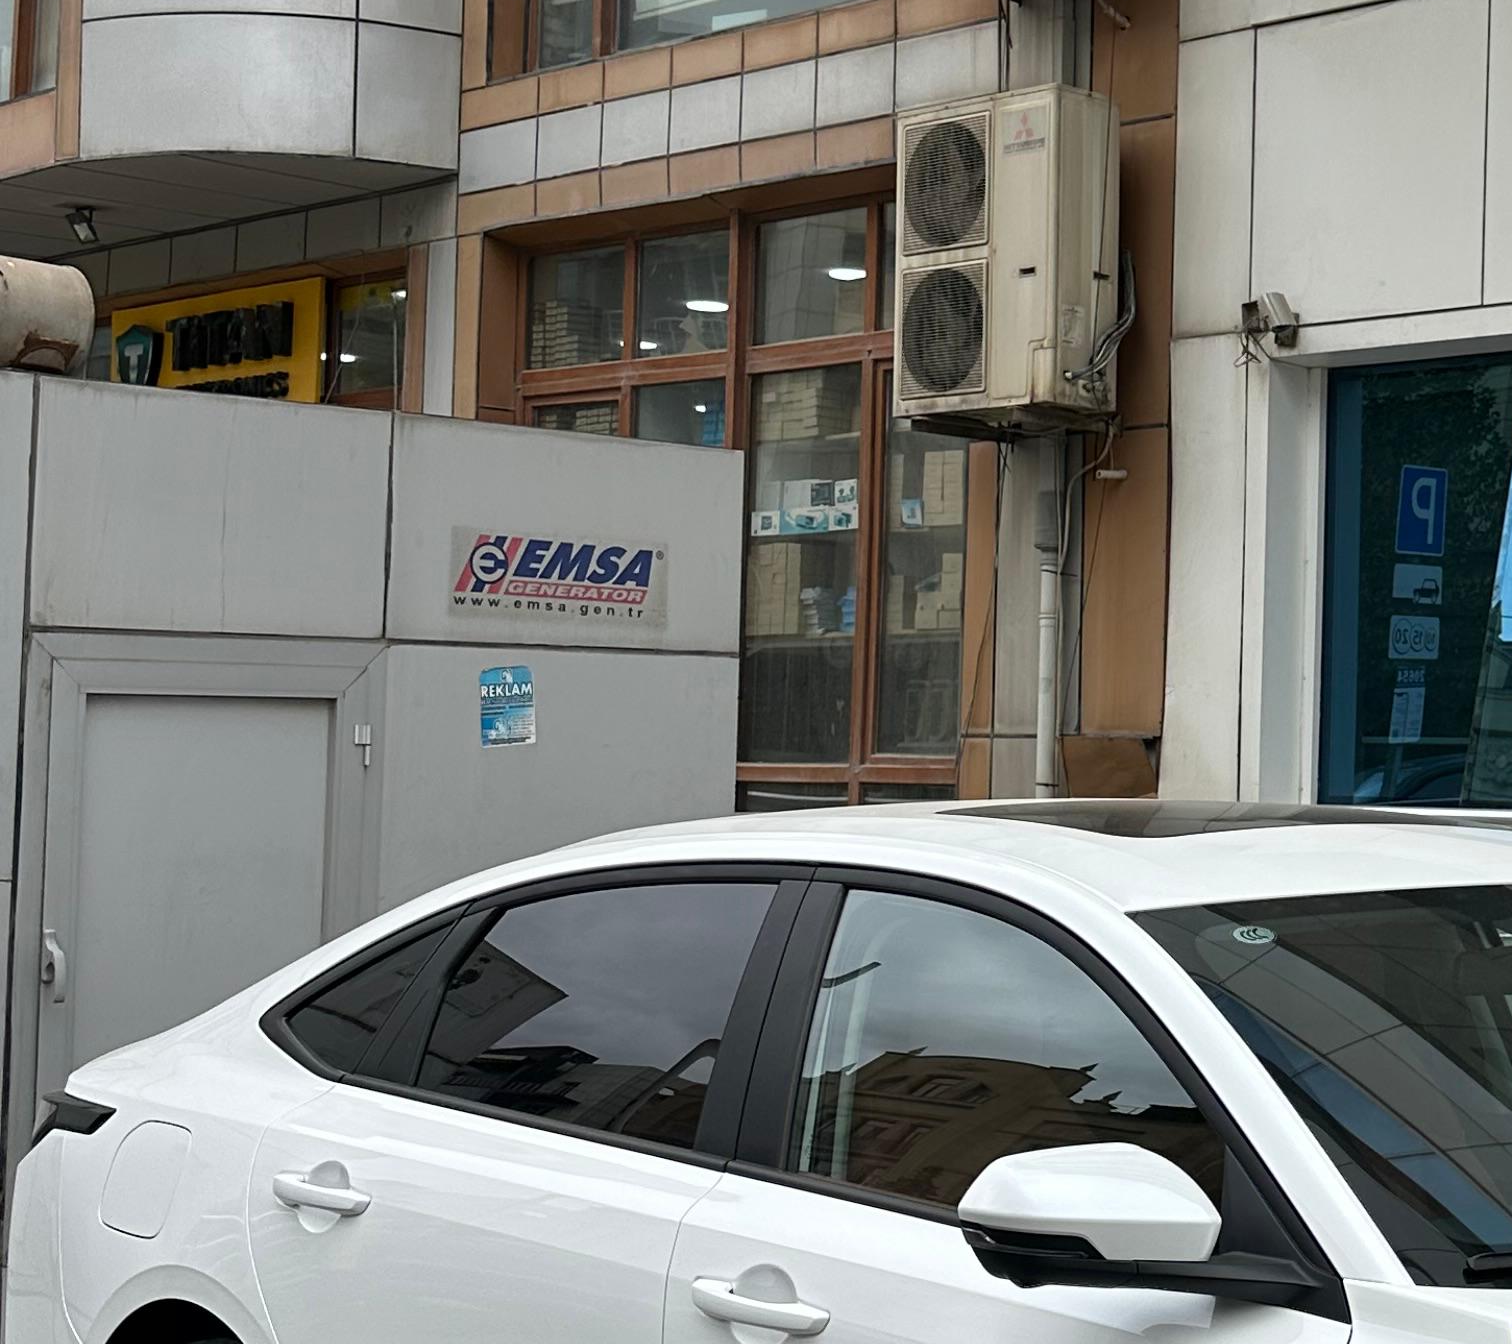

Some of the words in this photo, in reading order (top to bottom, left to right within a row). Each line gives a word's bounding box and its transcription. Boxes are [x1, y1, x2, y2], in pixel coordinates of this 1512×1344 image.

[513, 539, 654, 588] EMSA
[507, 582, 643, 603] GENERATOR
[453, 595, 645, 619] www.emsa.gen.tr
[480, 682, 533, 698] REKLAM
